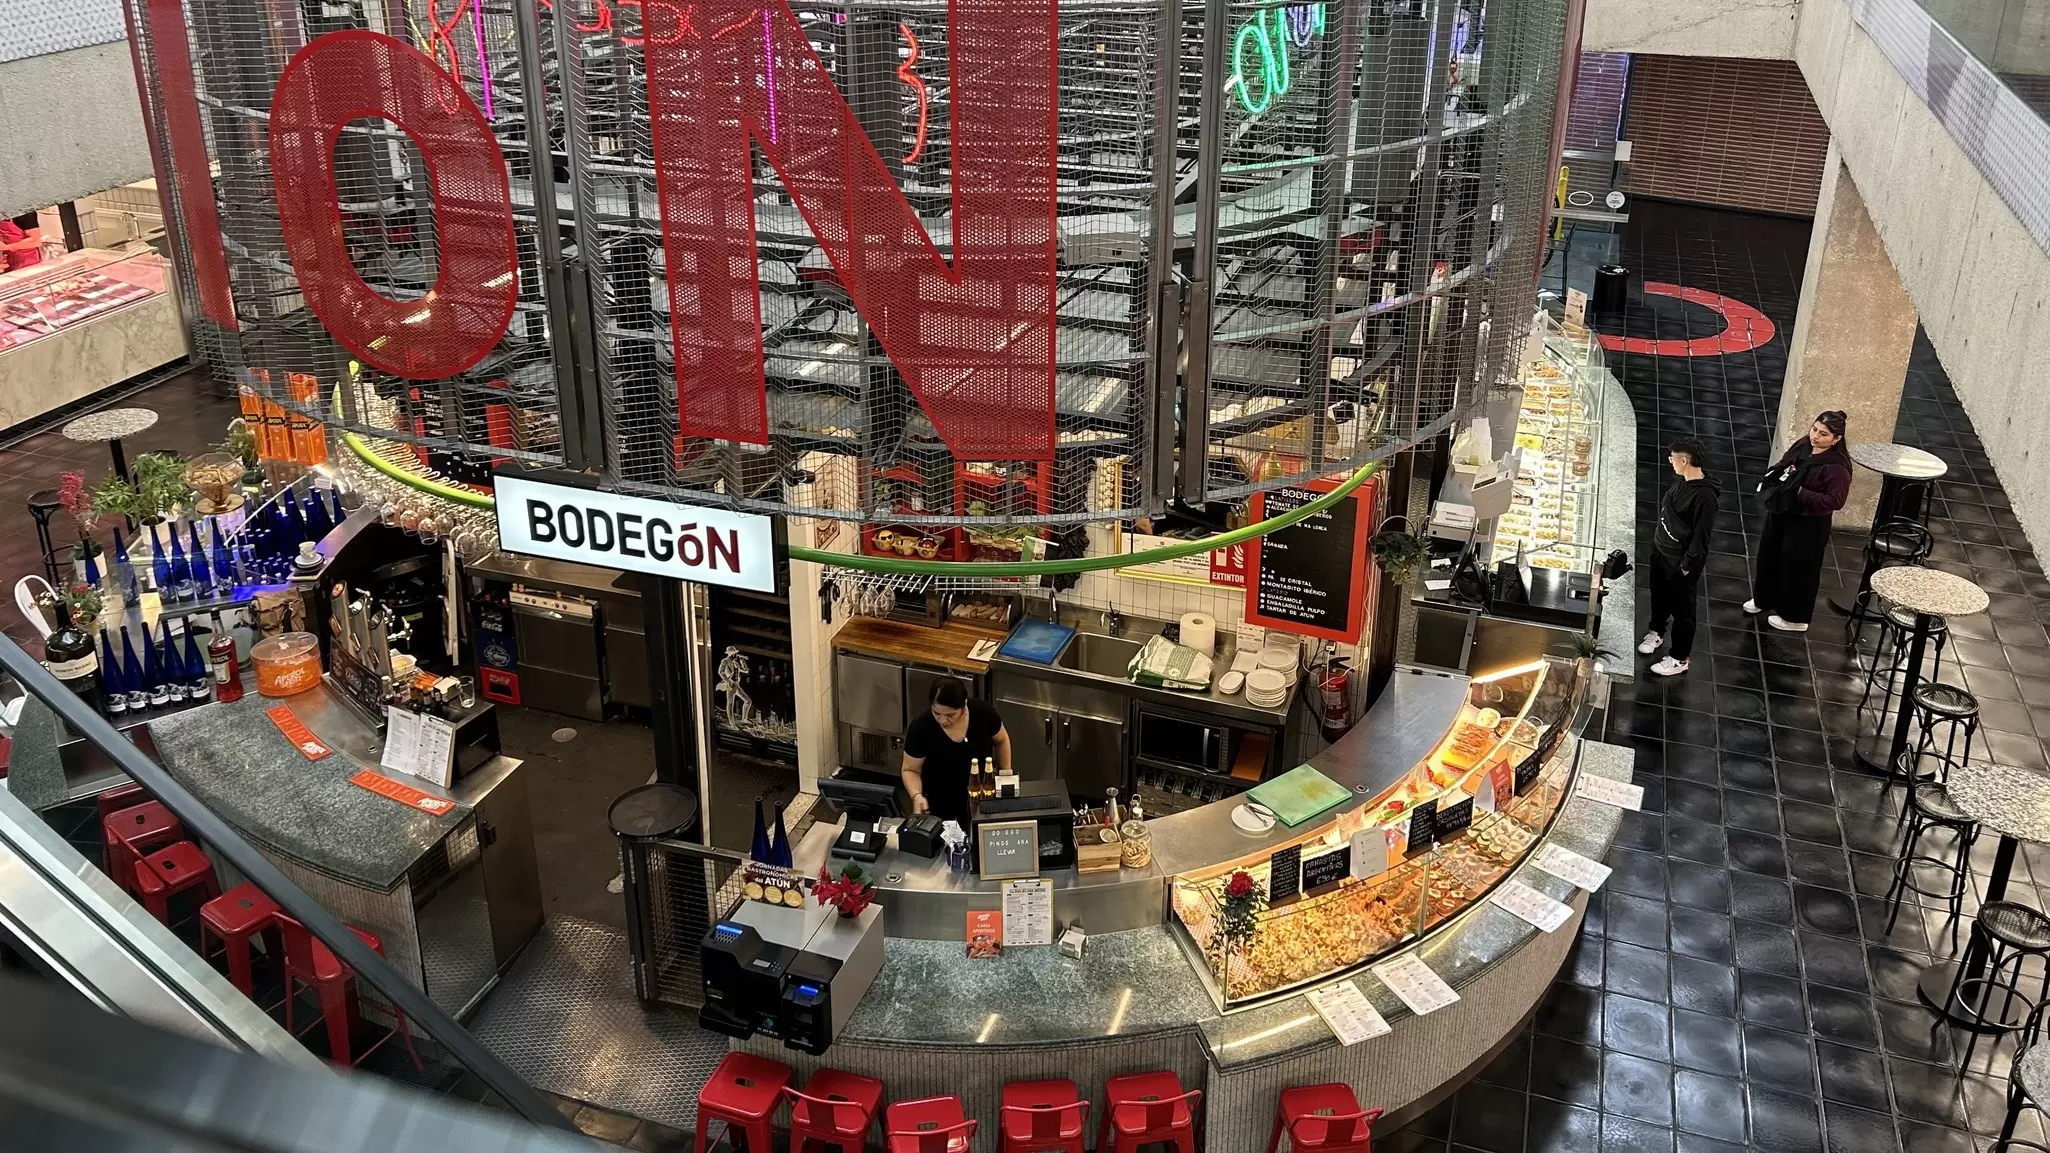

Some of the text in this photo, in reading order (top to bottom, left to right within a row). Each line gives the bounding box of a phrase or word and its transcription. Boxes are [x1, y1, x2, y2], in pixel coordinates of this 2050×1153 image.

[1212, 572, 1244, 584] EXTINTOR
[1288, 578, 1312, 587] CRISTAL
[1266, 581, 1302, 592] MONTADITO
[1266, 593, 1302, 605] GUACAMOLE
[1266, 605, 1286, 614] TARTAR
[1308, 606, 1326, 615] PULPO
[746, 866, 798, 880] GASTRONÓMICAS
[756, 862, 788, 873] JORNADAS
[764, 876, 790, 888] ATÚN
